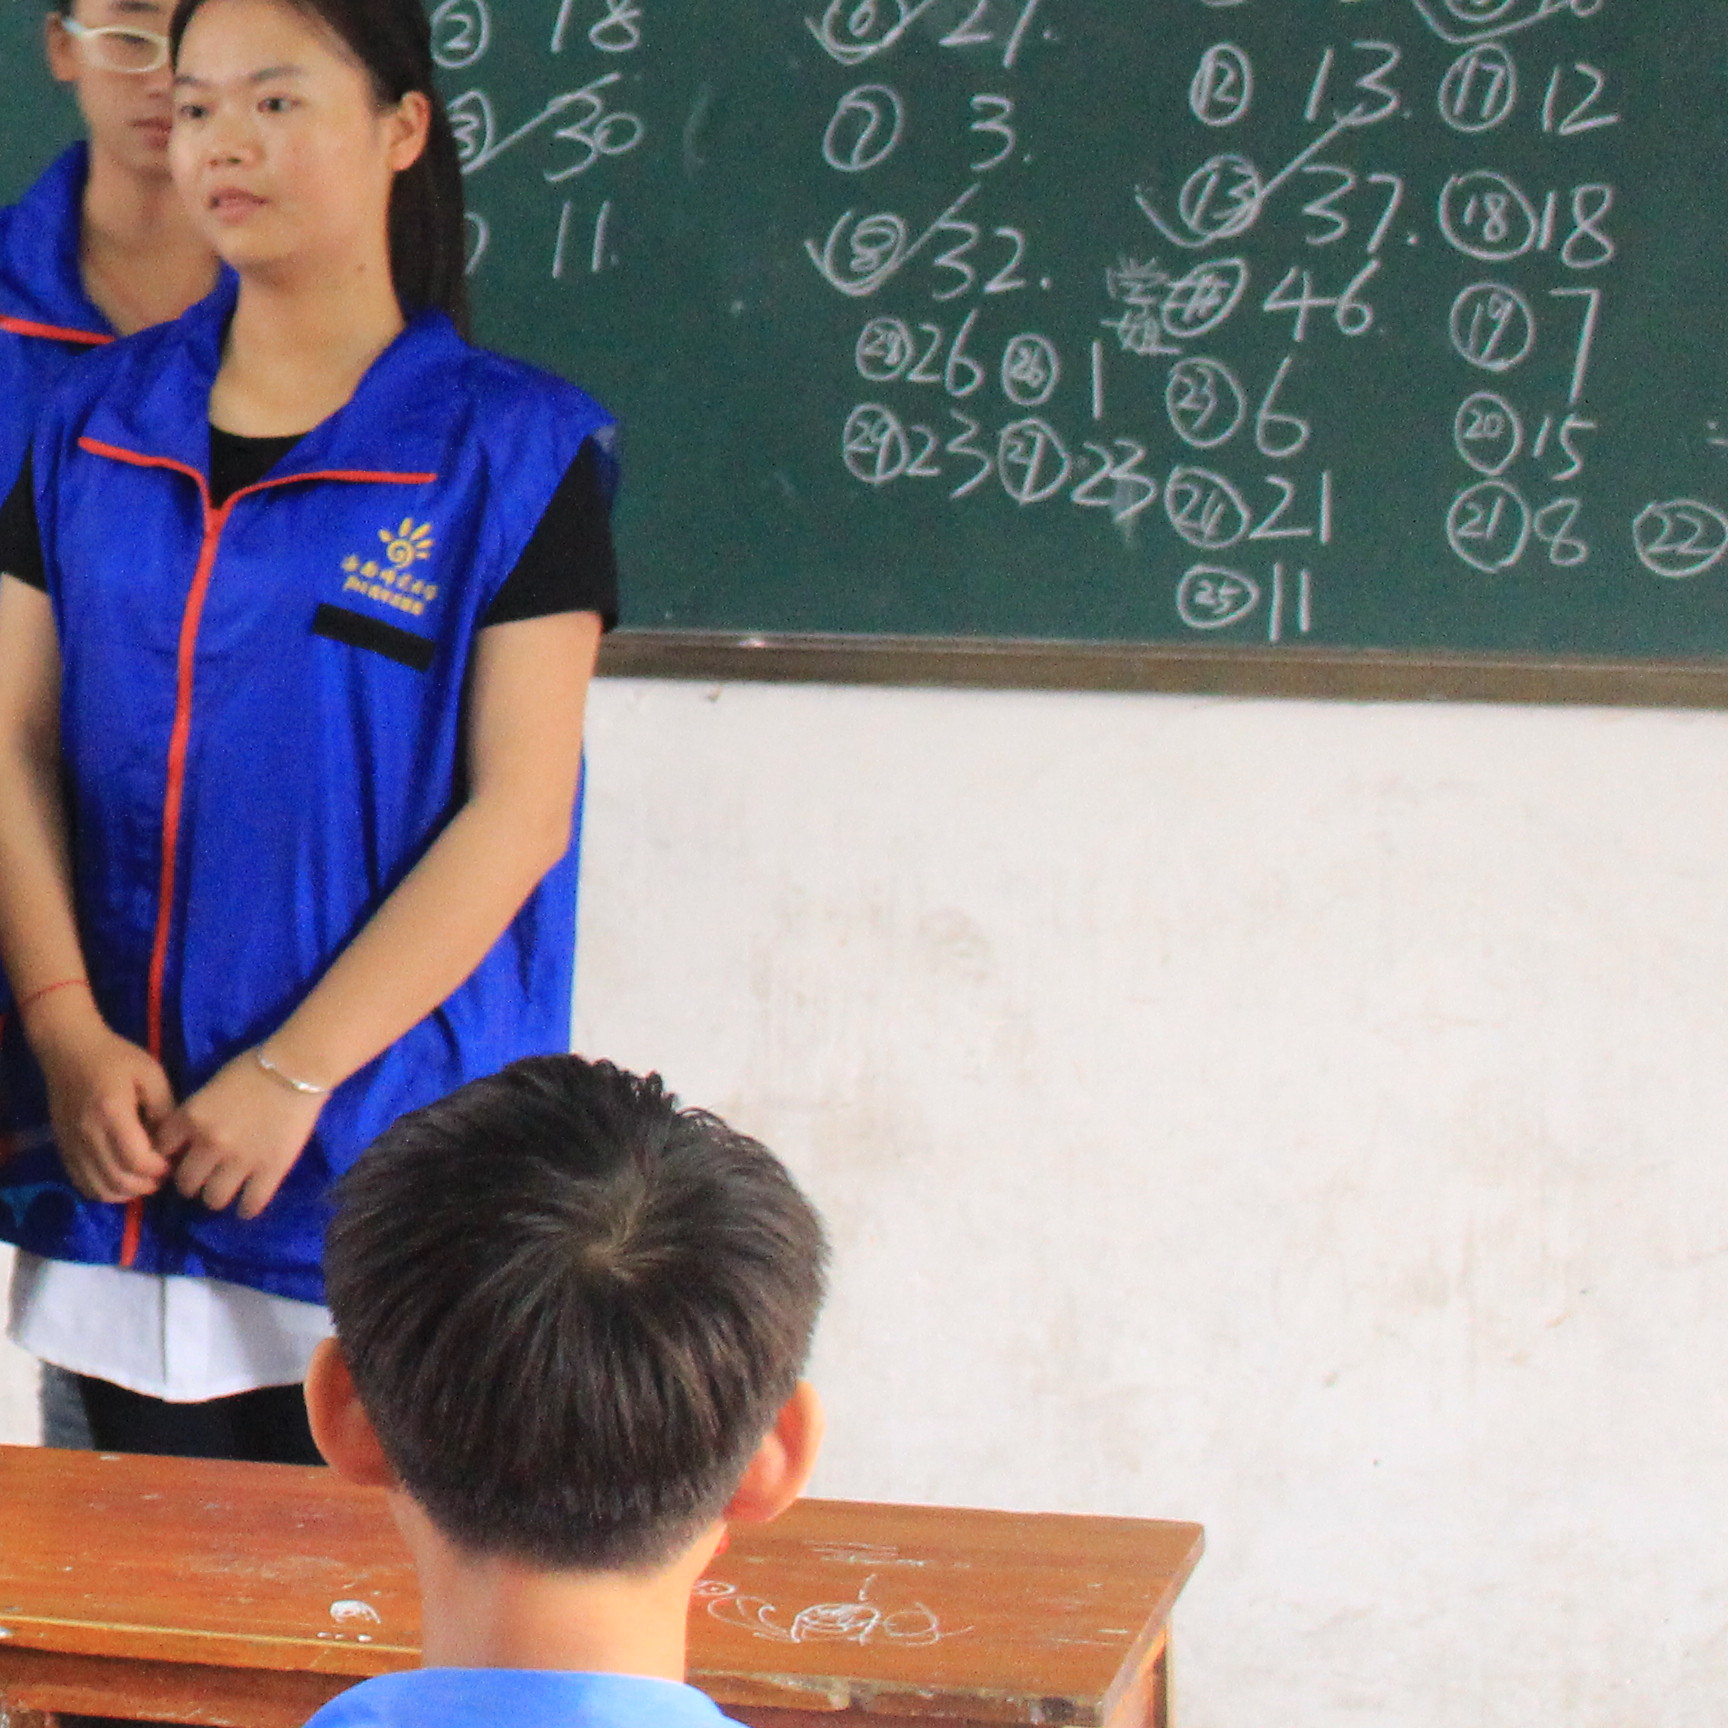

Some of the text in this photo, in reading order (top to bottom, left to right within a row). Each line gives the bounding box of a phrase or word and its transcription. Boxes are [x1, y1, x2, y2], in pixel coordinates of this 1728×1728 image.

[1543, 62, 1622, 136] 12
[1537, 183, 1615, 270] 18
[1263, 258, 1375, 342] 46
[906, 308, 985, 398] 26
[1547, 288, 1600, 405] 7
[1255, 355, 1310, 458] 6
[1532, 413, 1597, 481] 15
[905, 408, 994, 500] 23
[1249, 470, 1333, 546] 21
[1533, 498, 1588, 566] 8
